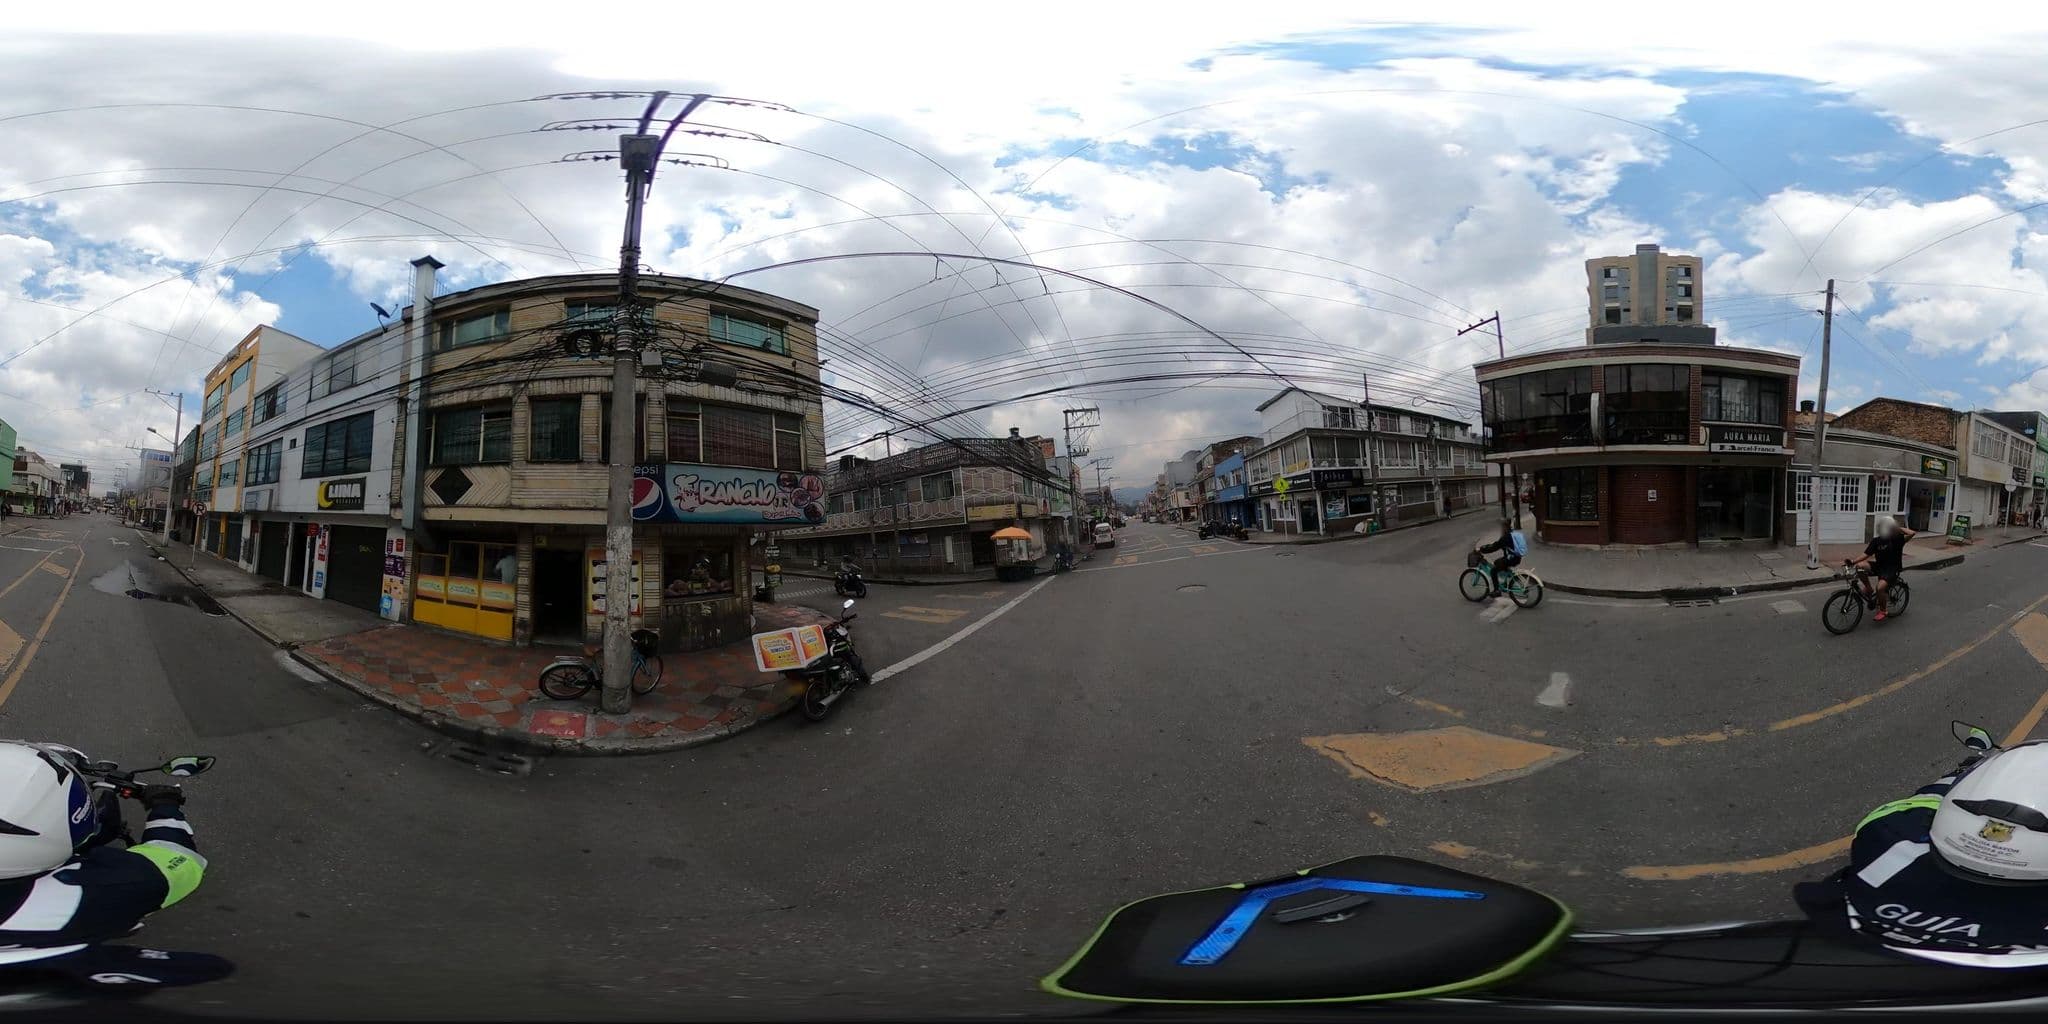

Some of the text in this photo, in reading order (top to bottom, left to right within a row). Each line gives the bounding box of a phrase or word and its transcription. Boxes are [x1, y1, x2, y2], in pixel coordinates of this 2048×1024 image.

[1724, 431, 1771, 442] AURA MARIA
[633, 464, 660, 477] epsi
[699, 478, 776, 506] RANCHO
